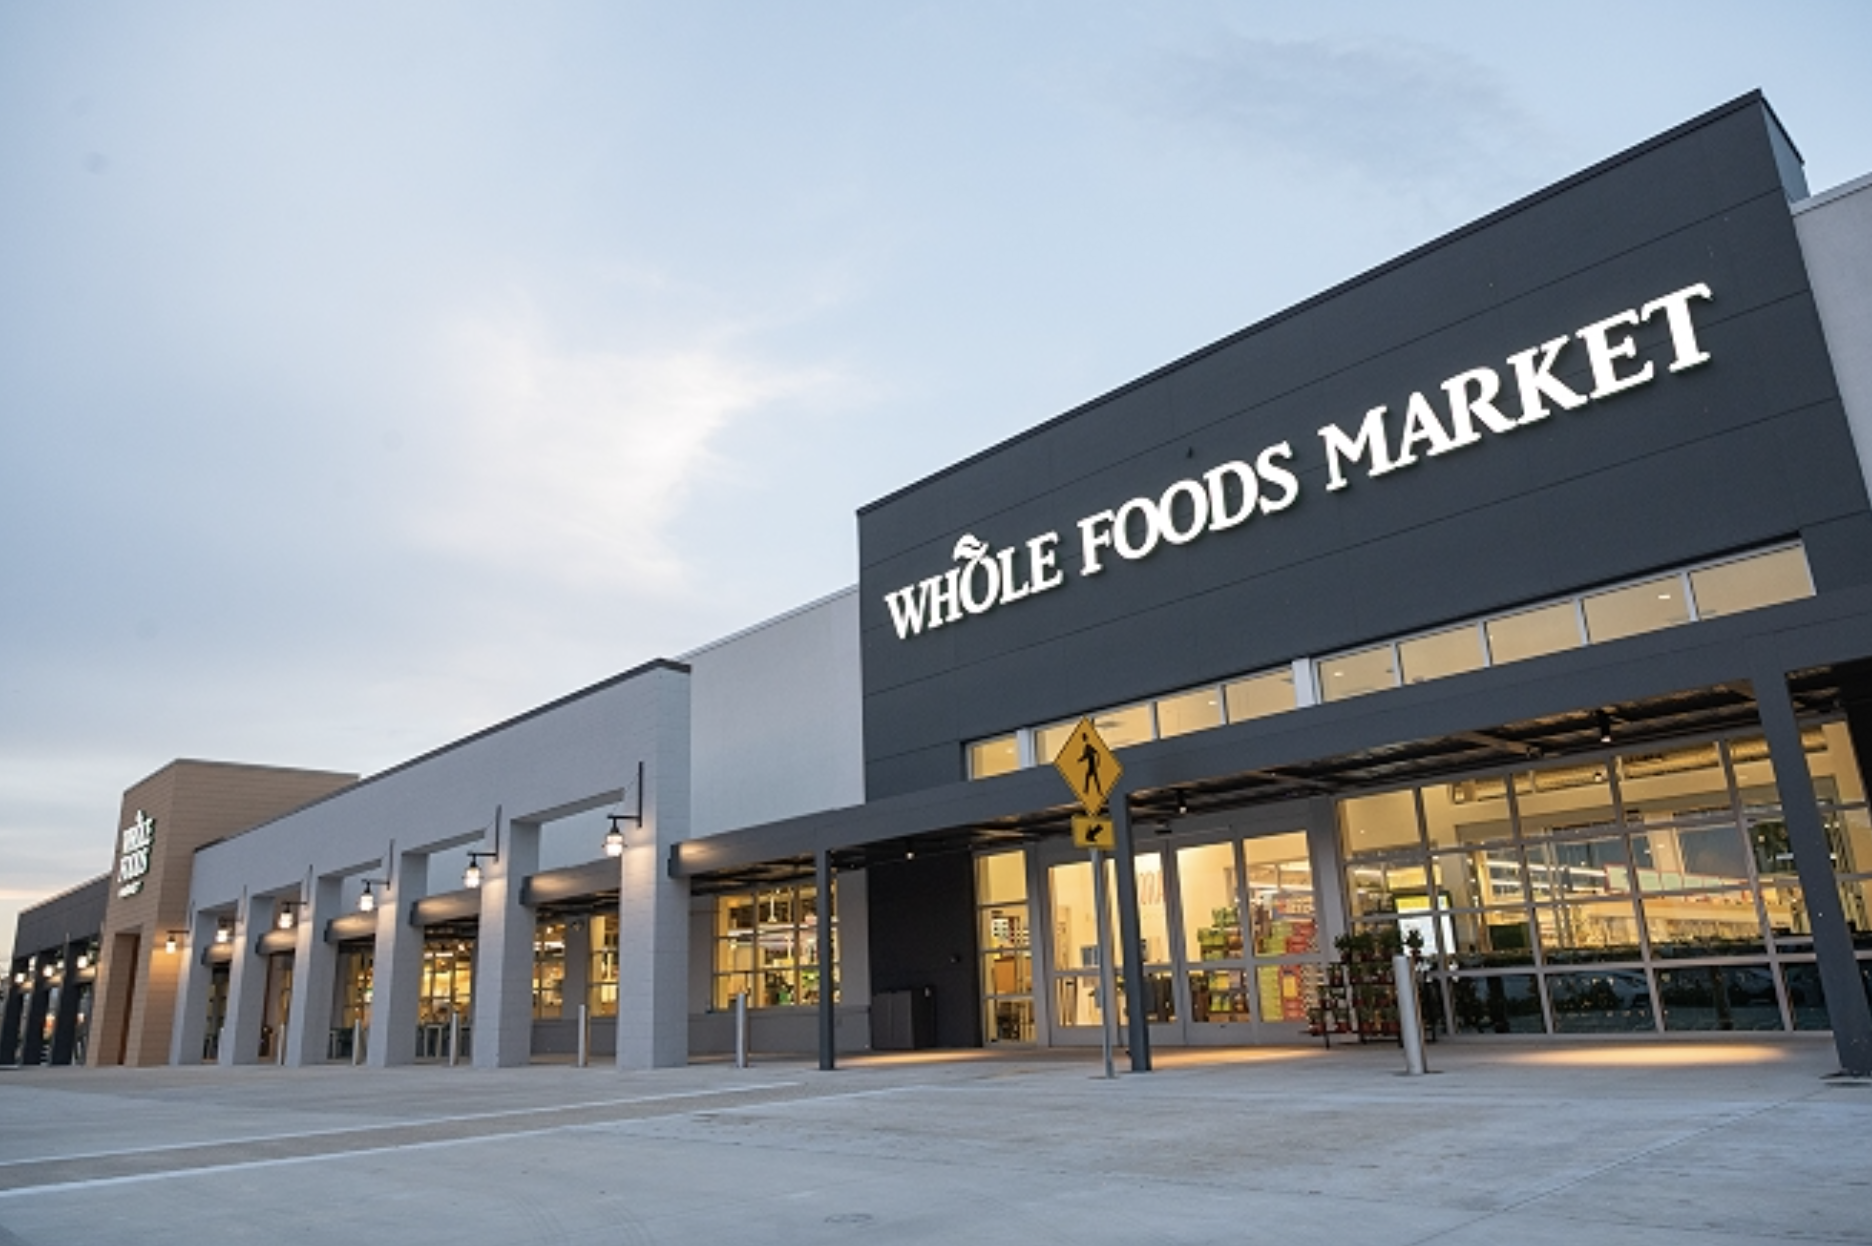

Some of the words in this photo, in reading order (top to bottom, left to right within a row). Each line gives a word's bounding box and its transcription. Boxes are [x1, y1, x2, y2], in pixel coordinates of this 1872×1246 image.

[884, 532, 1063, 640] WHOLE
[1076, 440, 1299, 577] FOODS
[1317, 282, 1712, 491] MARKET
